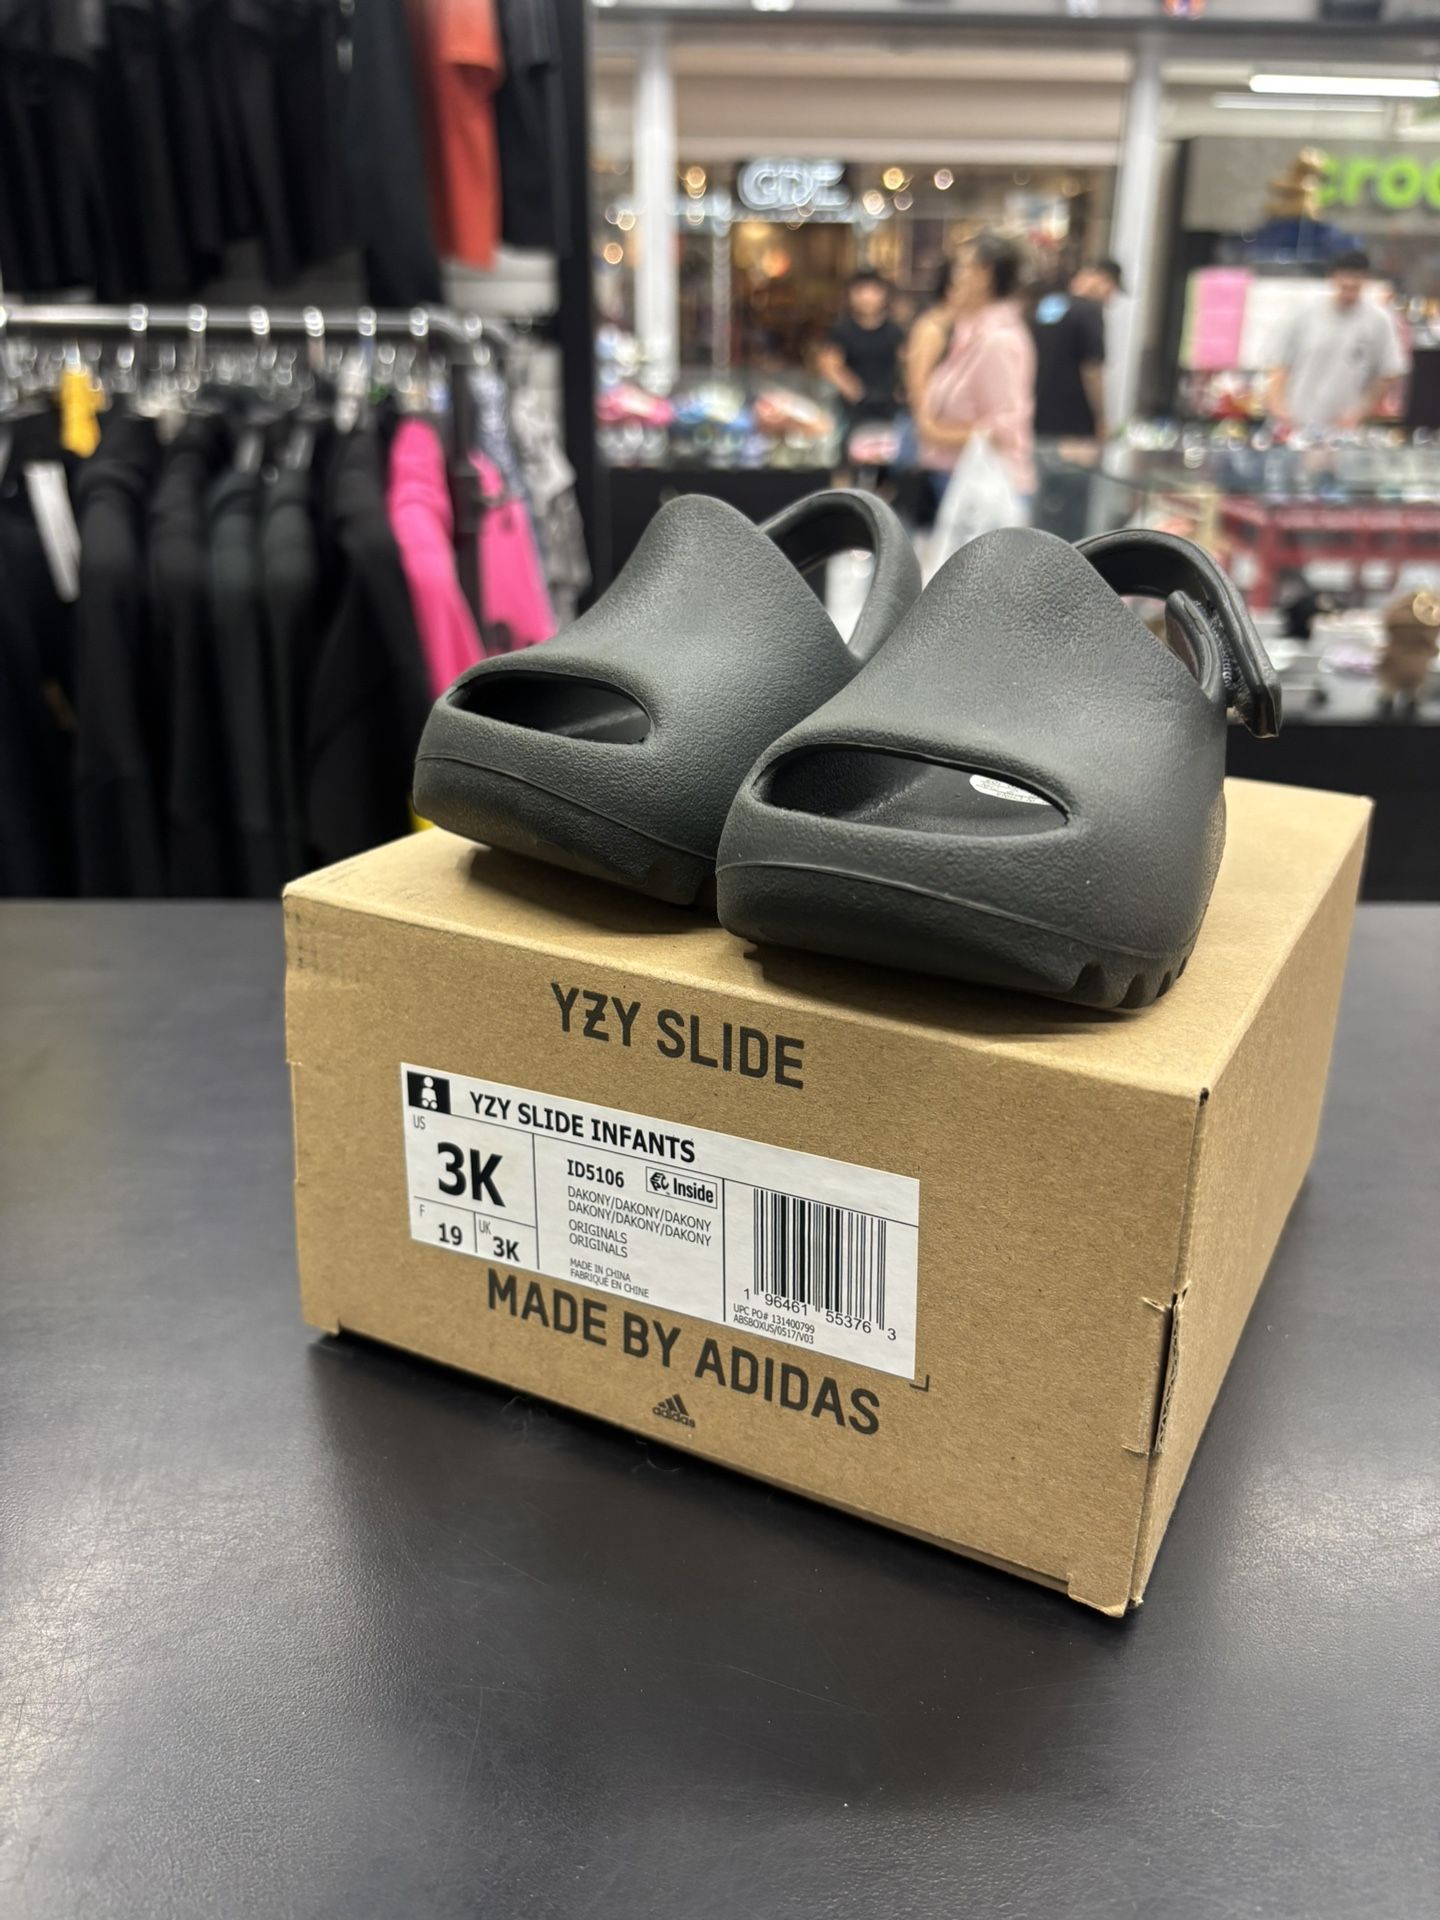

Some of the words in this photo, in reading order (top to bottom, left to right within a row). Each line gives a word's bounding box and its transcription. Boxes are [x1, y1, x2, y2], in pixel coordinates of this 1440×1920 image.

[656, 1008, 805, 1090] SLIDE
[413, 1114, 426, 1130] US
[469, 1090, 511, 1120] YZY
[518, 1102, 585, 1138] SLIDE
[591, 1118, 696, 1163] INFANTS
[437, 1141, 506, 1208] 3K
[567, 1158, 625, 1188] ID5106
[673, 1177, 714, 1203] Inside
[419, 1203, 426, 1217] F
[567, 1185, 712, 1233] DAKONY/DAKONY/DAKONY
[438, 1222, 463, 1246] 19
[478, 1219, 492, 1236] UK
[568, 1200, 712, 1247] DAKONY/DAKONY/DAKONY
[568, 1219, 628, 1245] ORIGINALS
[492, 1236, 521, 1263] 3K
[569, 1233, 628, 1258] ORIGINALS
[570, 1258, 593, 1271] MADE
[595, 1263, 603, 1274] IN
[605, 1267, 632, 1283] CHINA
[611, 1280, 622, 1291] EN
[624, 1284, 649, 1298] CHINE
[733, 1303, 749, 1316] UPC
[751, 1308, 769, 1320] PO#
[772, 1314, 815, 1334] 131400799
[743, 1287, 750, 1300] 1
[764, 1293, 808, 1316] 96461
[825, 1311, 872, 1334] 55376
[887, 1327, 897, 1341] 3
[487, 1267, 608, 1347] MADE
[623, 1310, 682, 1369] BY
[694, 1337, 881, 1436] ADIDAS
[652, 1405, 696, 1428] adidas
